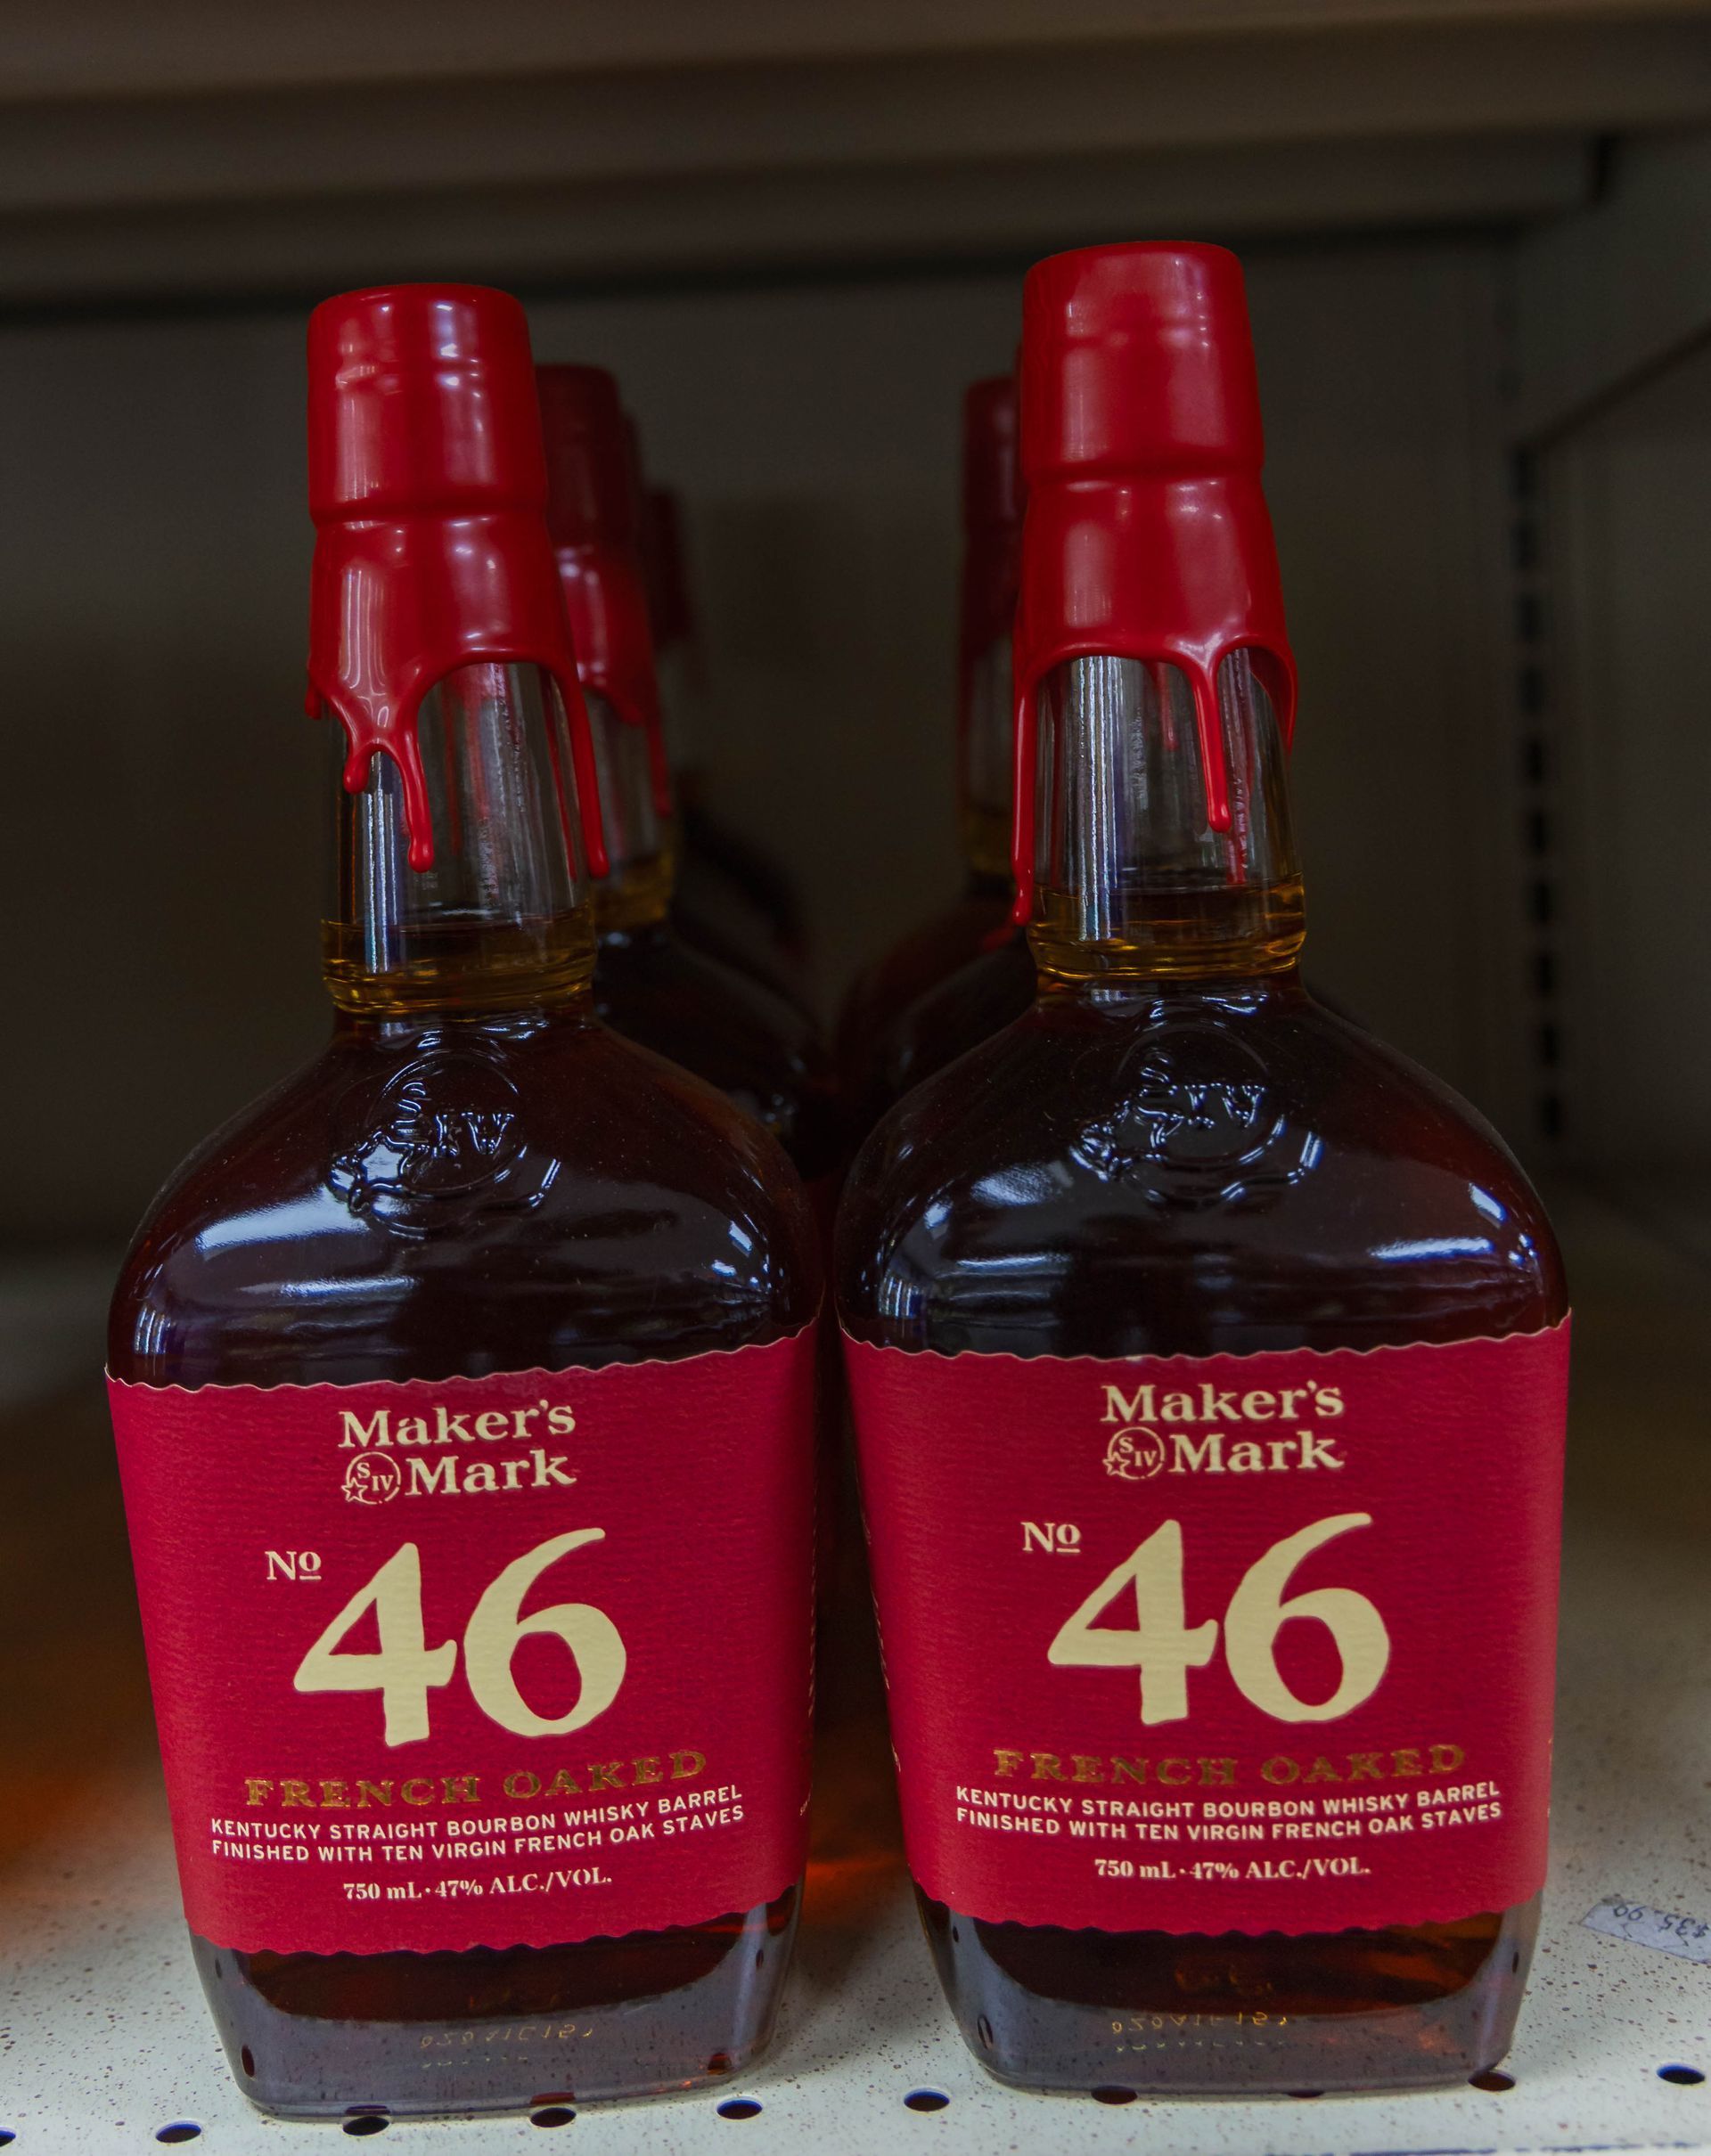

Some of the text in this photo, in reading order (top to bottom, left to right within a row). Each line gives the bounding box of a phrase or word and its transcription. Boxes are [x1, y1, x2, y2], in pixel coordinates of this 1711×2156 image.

[338, 1399, 577, 1449] Maker's
[1101, 1380, 1345, 1425] Maker's
[405, 1449, 578, 1497] Mark
[1169, 1430, 1346, 1474] Mark
[293, 1527, 627, 1747] 46
[1047, 1512, 1391, 1725] 46
[245, 1750, 707, 1808] FRENCH OAKED
[994, 1744, 1466, 1785] FRENCH OAKED
[211, 1784, 743, 1841] KENTUCKY STRAIGHT BOURBON WHISKY BARREL
[956, 1780, 1500, 1818] KENTUCKY STRAIGHT BOURBON WHISKY BARREL
[957, 1801, 1502, 1842] FINISHED WITH TEN VIRGIN FRENCH OAK STAVES
[212, 1804, 745, 1862] FINISHED WITH TEN VIRGIN FRENCH OAK STAVES
[343, 1882, 381, 1900] 750
[1094, 1858, 1134, 1878] 750
